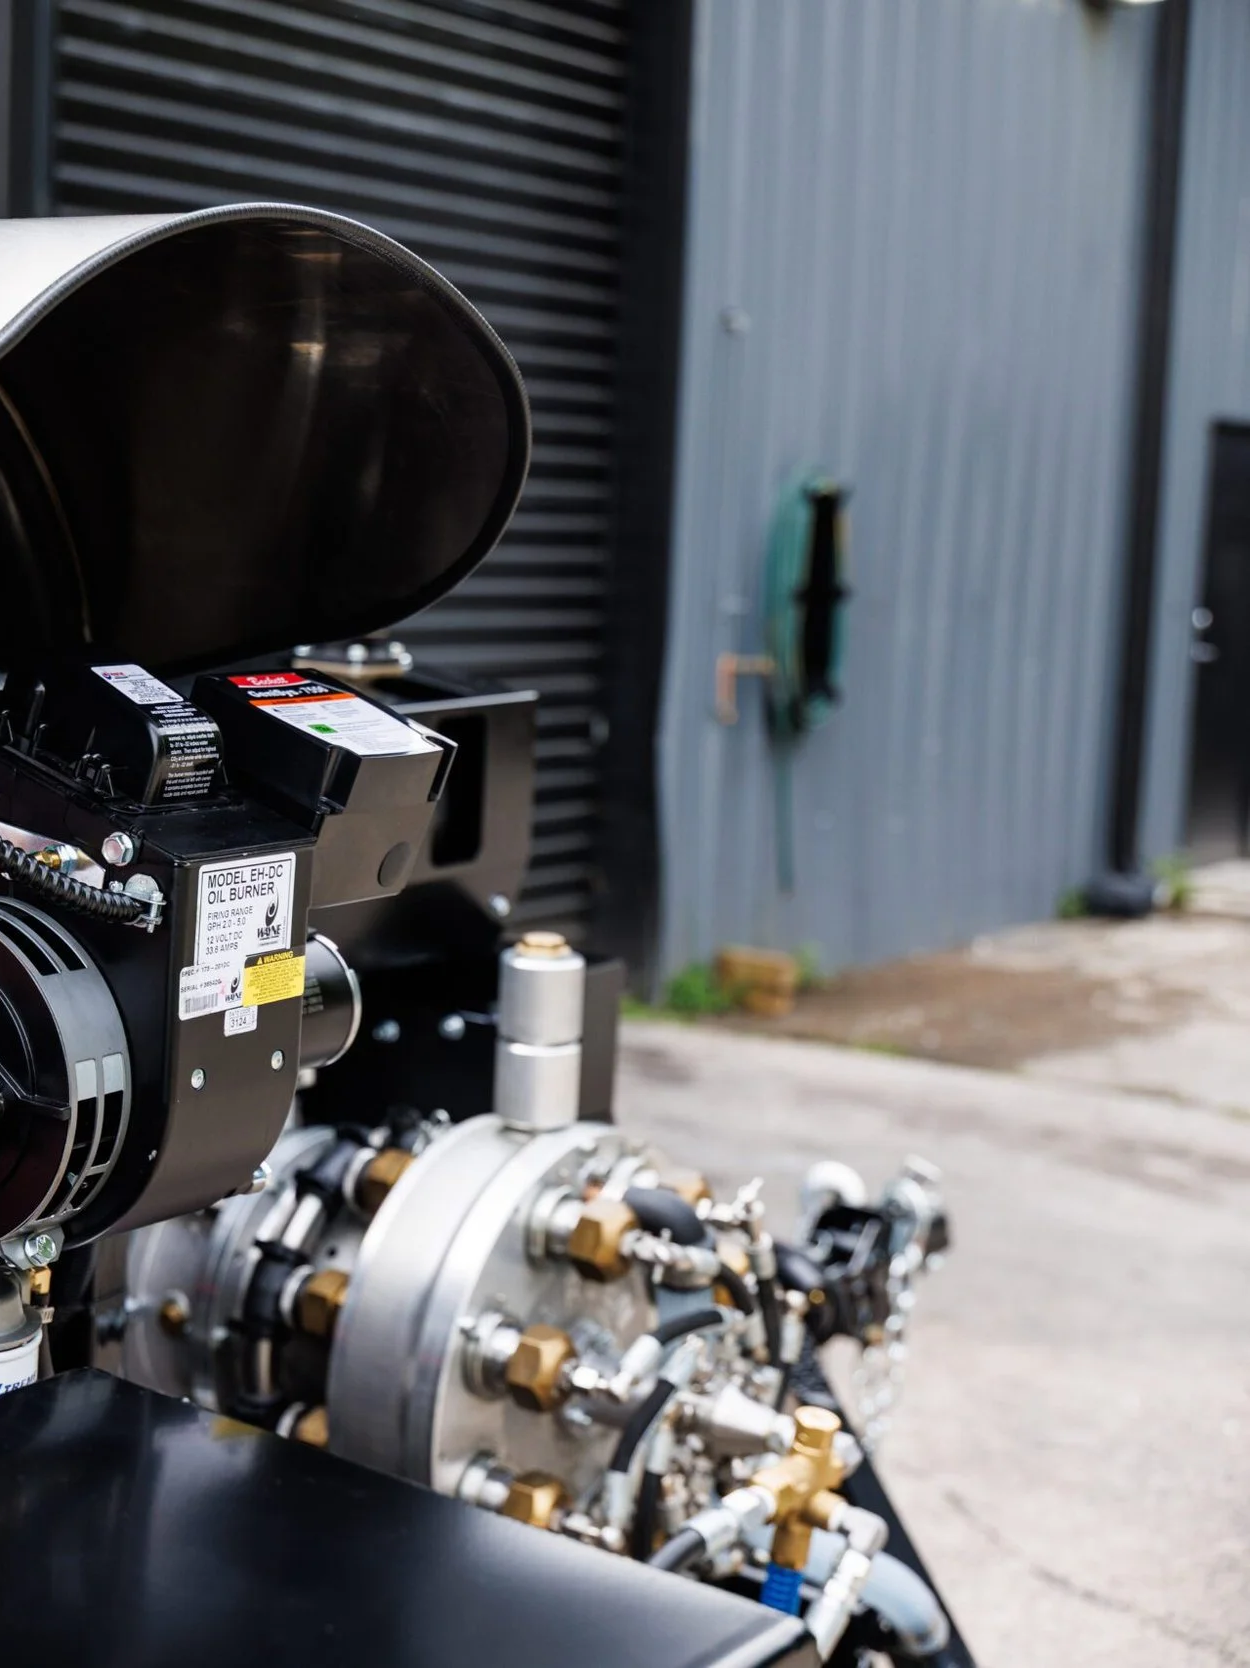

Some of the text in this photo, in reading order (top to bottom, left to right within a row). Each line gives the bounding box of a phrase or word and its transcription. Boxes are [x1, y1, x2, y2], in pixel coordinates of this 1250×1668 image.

[207, 864, 284, 889] MODEL EH-DC
[207, 881, 275, 905] OIL BURNER
[207, 905, 253, 921] FIRING RANGE
[207, 922, 221, 931] GPH
[222, 919, 232, 928] 2.0
[257, 924, 282, 939] WAYNE
[207, 930, 243, 944] 12 VOLT DC
[220, 941, 238, 952] AMPS
[263, 951, 294, 964] WARNING
[180, 984, 198, 993] SERIAL
[230, 1017, 247, 1028] 3124
